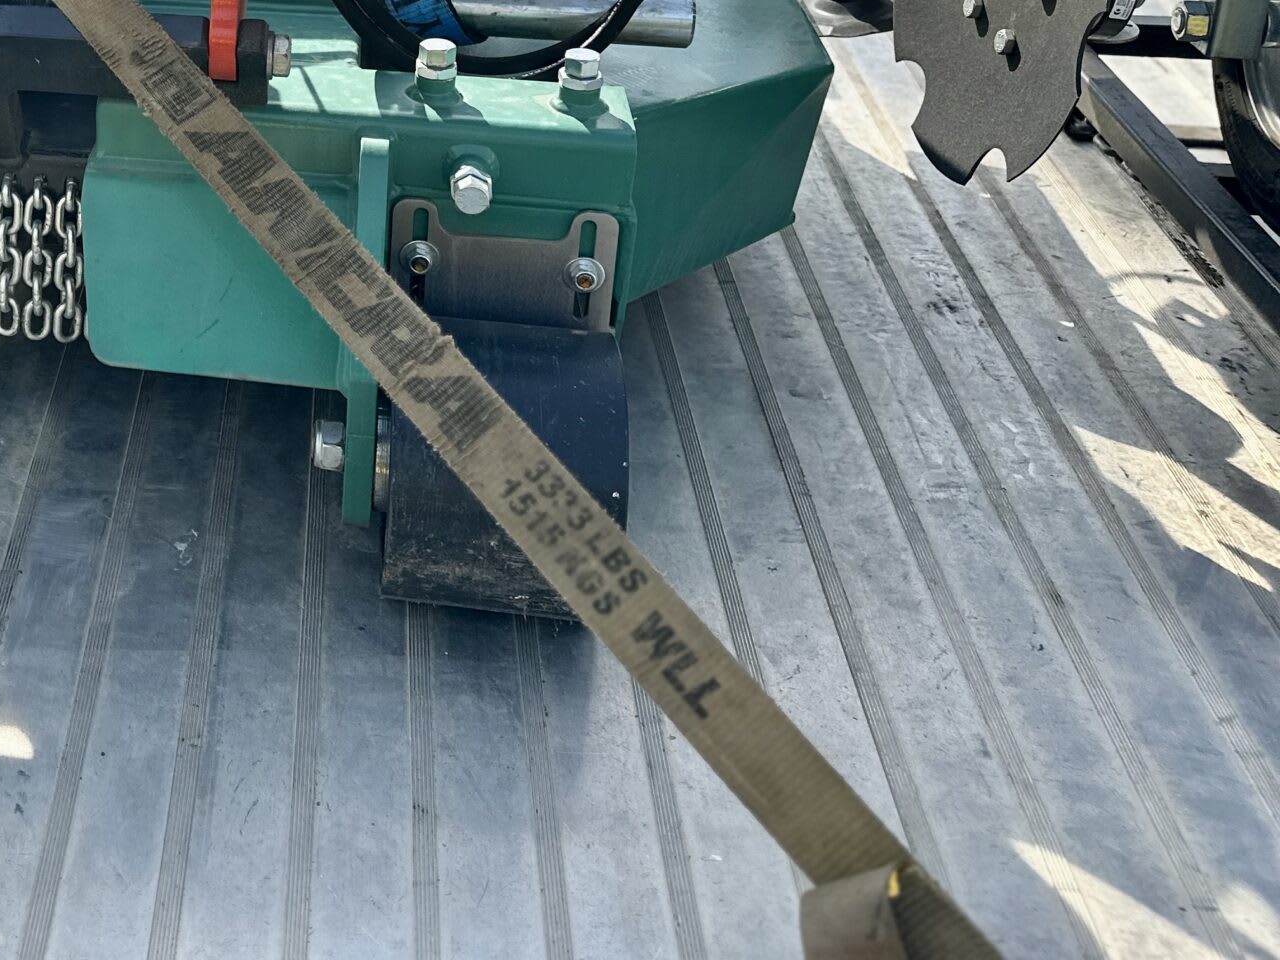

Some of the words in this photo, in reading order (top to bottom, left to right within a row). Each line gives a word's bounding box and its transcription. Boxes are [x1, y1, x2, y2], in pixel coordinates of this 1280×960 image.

[183, 130, 502, 453] ANCRA
[501, 478, 565, 546] 1515
[555, 550, 620, 615] KGS
[584, 532, 648, 594] LBS
[631, 609, 721, 720] WLL
